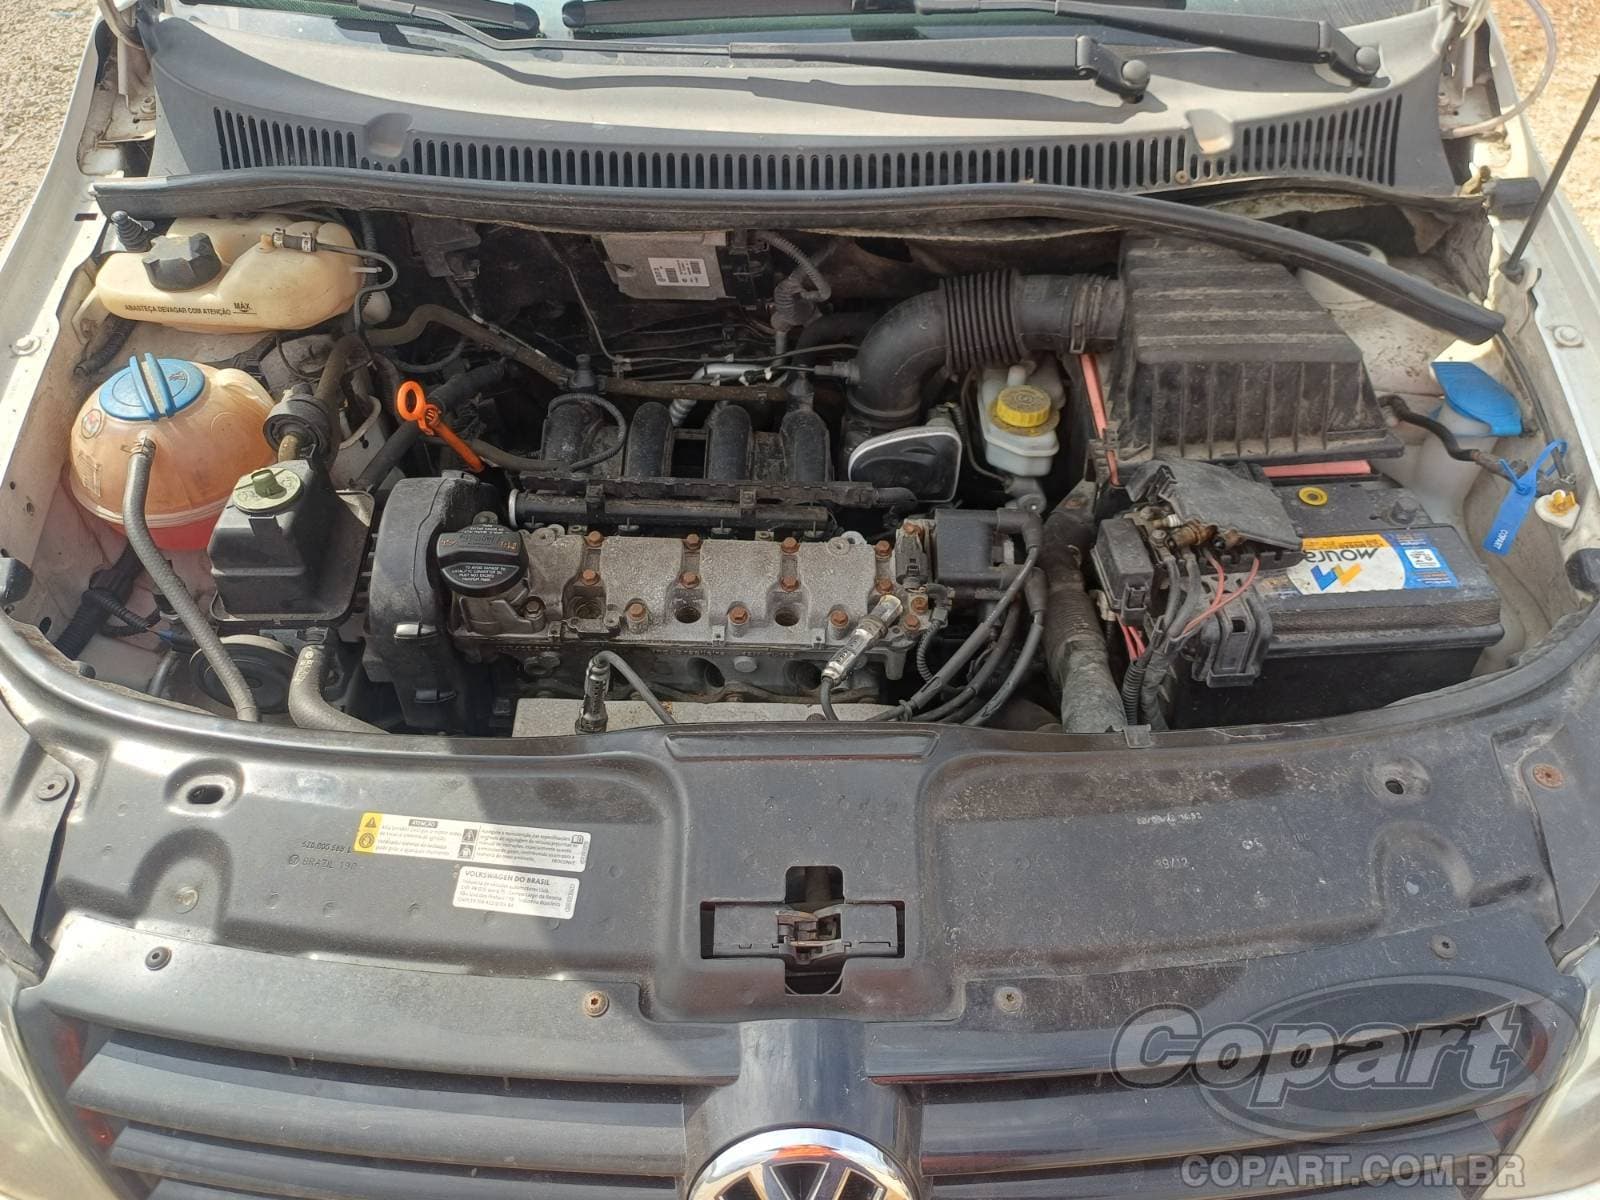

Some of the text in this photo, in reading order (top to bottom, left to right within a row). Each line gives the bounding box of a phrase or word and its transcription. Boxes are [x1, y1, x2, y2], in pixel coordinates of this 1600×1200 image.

[125, 304, 157, 313] ABASTEÇA
[158, 306, 187, 314] DEVAGAR
[203, 307, 232, 316] ATENÇÃO
[465, 870, 551, 886] VOLKSWAGEN DO BRASIL
